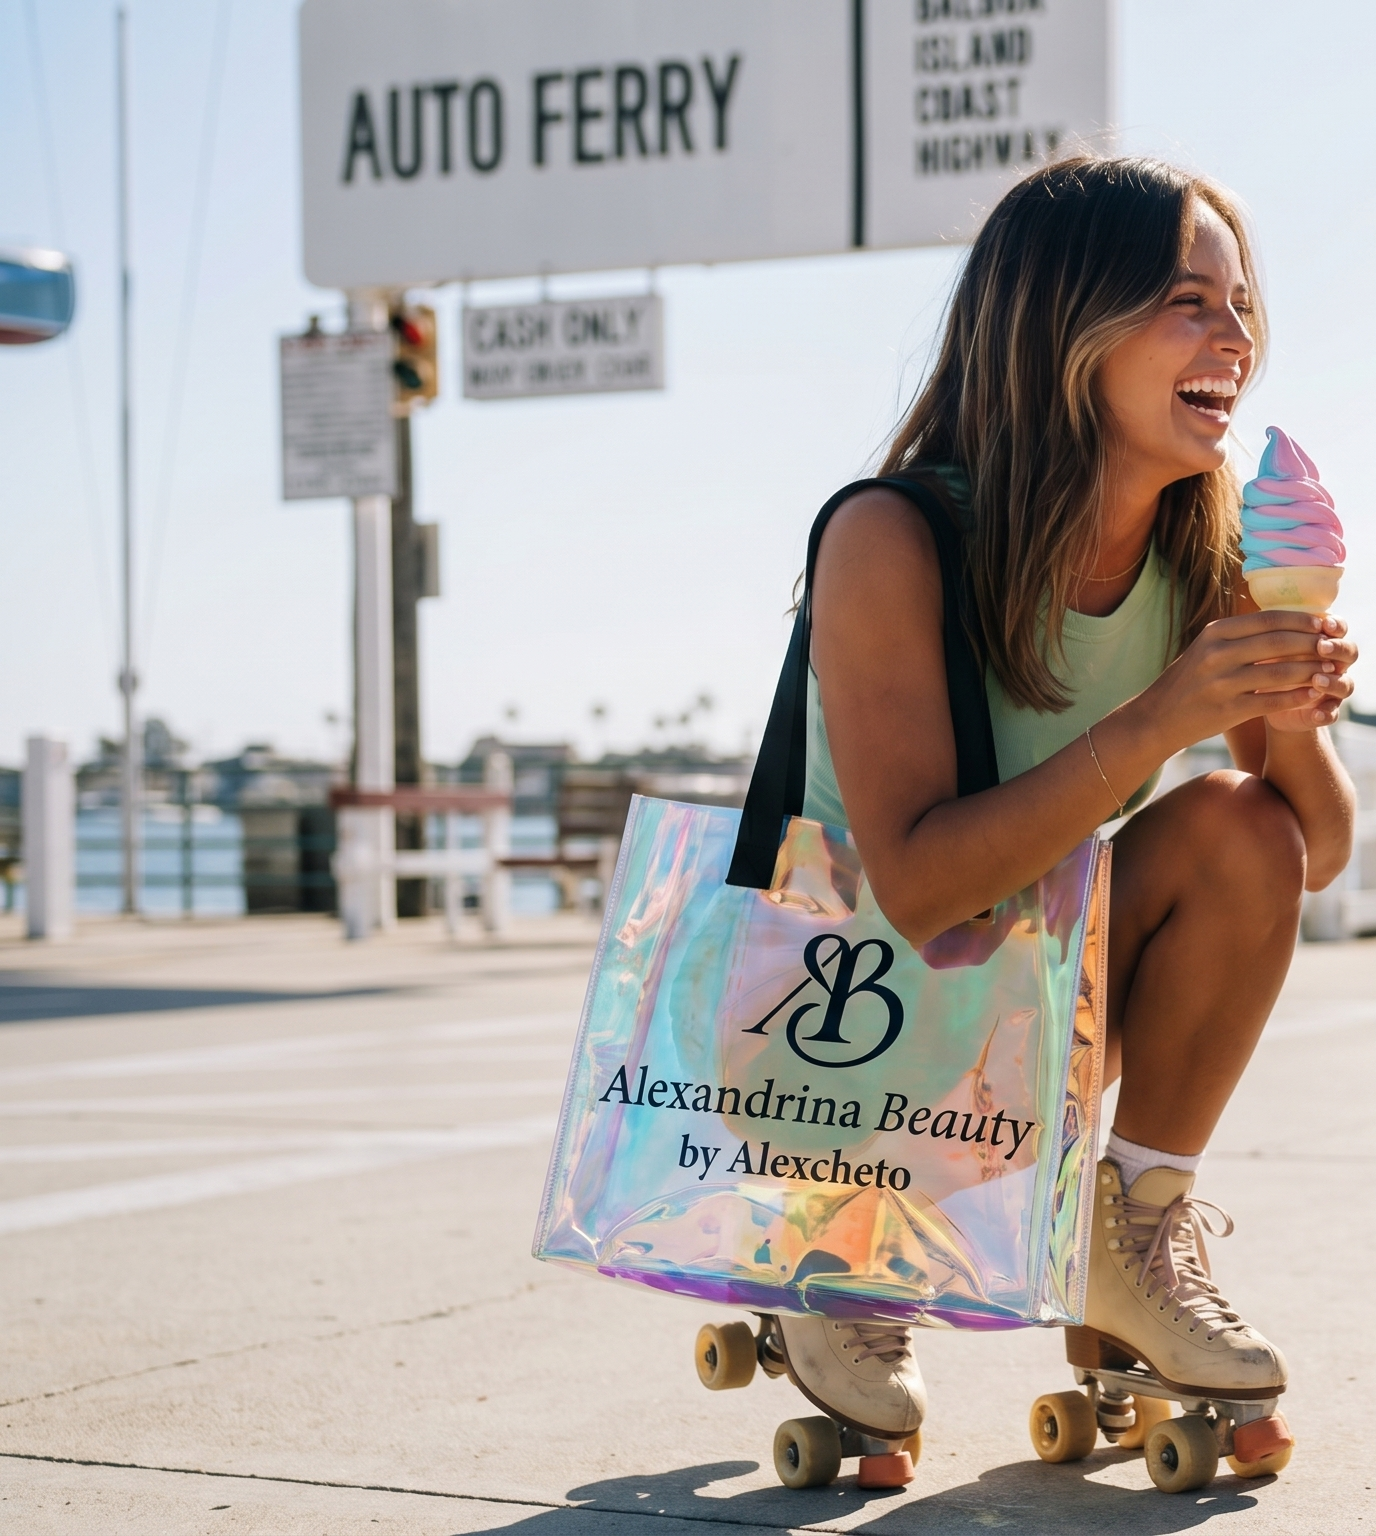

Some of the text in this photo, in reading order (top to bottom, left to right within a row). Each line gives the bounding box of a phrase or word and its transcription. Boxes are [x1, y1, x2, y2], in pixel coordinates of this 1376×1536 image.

[915, 27, 1034, 73] ISLAND
[341, 53, 742, 186] AUTO FERRY
[915, 77, 1020, 124] COAST
[470, 306, 647, 355] CASH ONLY
[598, 1064, 1037, 1162] Alexandrina Beauty
[677, 1133, 912, 1192] by Alexcheto
